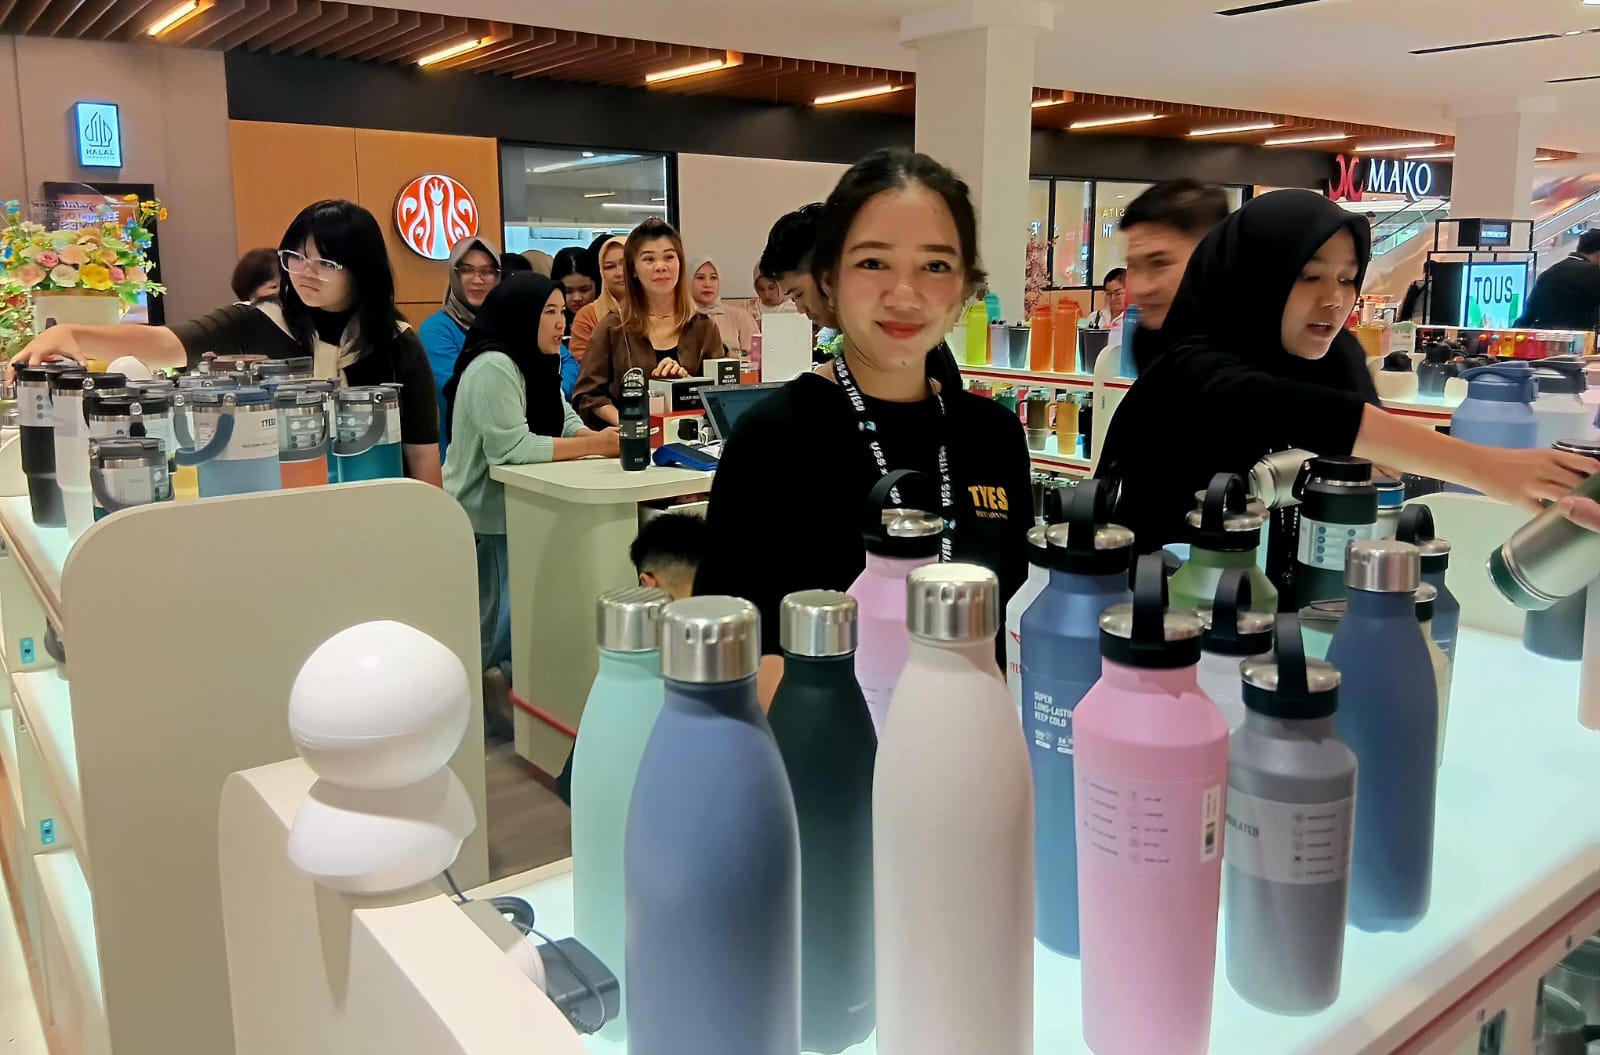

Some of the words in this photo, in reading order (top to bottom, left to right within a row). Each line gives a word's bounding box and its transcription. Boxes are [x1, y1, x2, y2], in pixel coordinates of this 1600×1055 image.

[1366, 158, 1432, 202] MAKO
[1474, 275, 1513, 305] TOUS
[941, 537, 952, 561] YESO
[1034, 690, 1053, 705] SUPER
[1049, 715, 1067, 727] COLD
